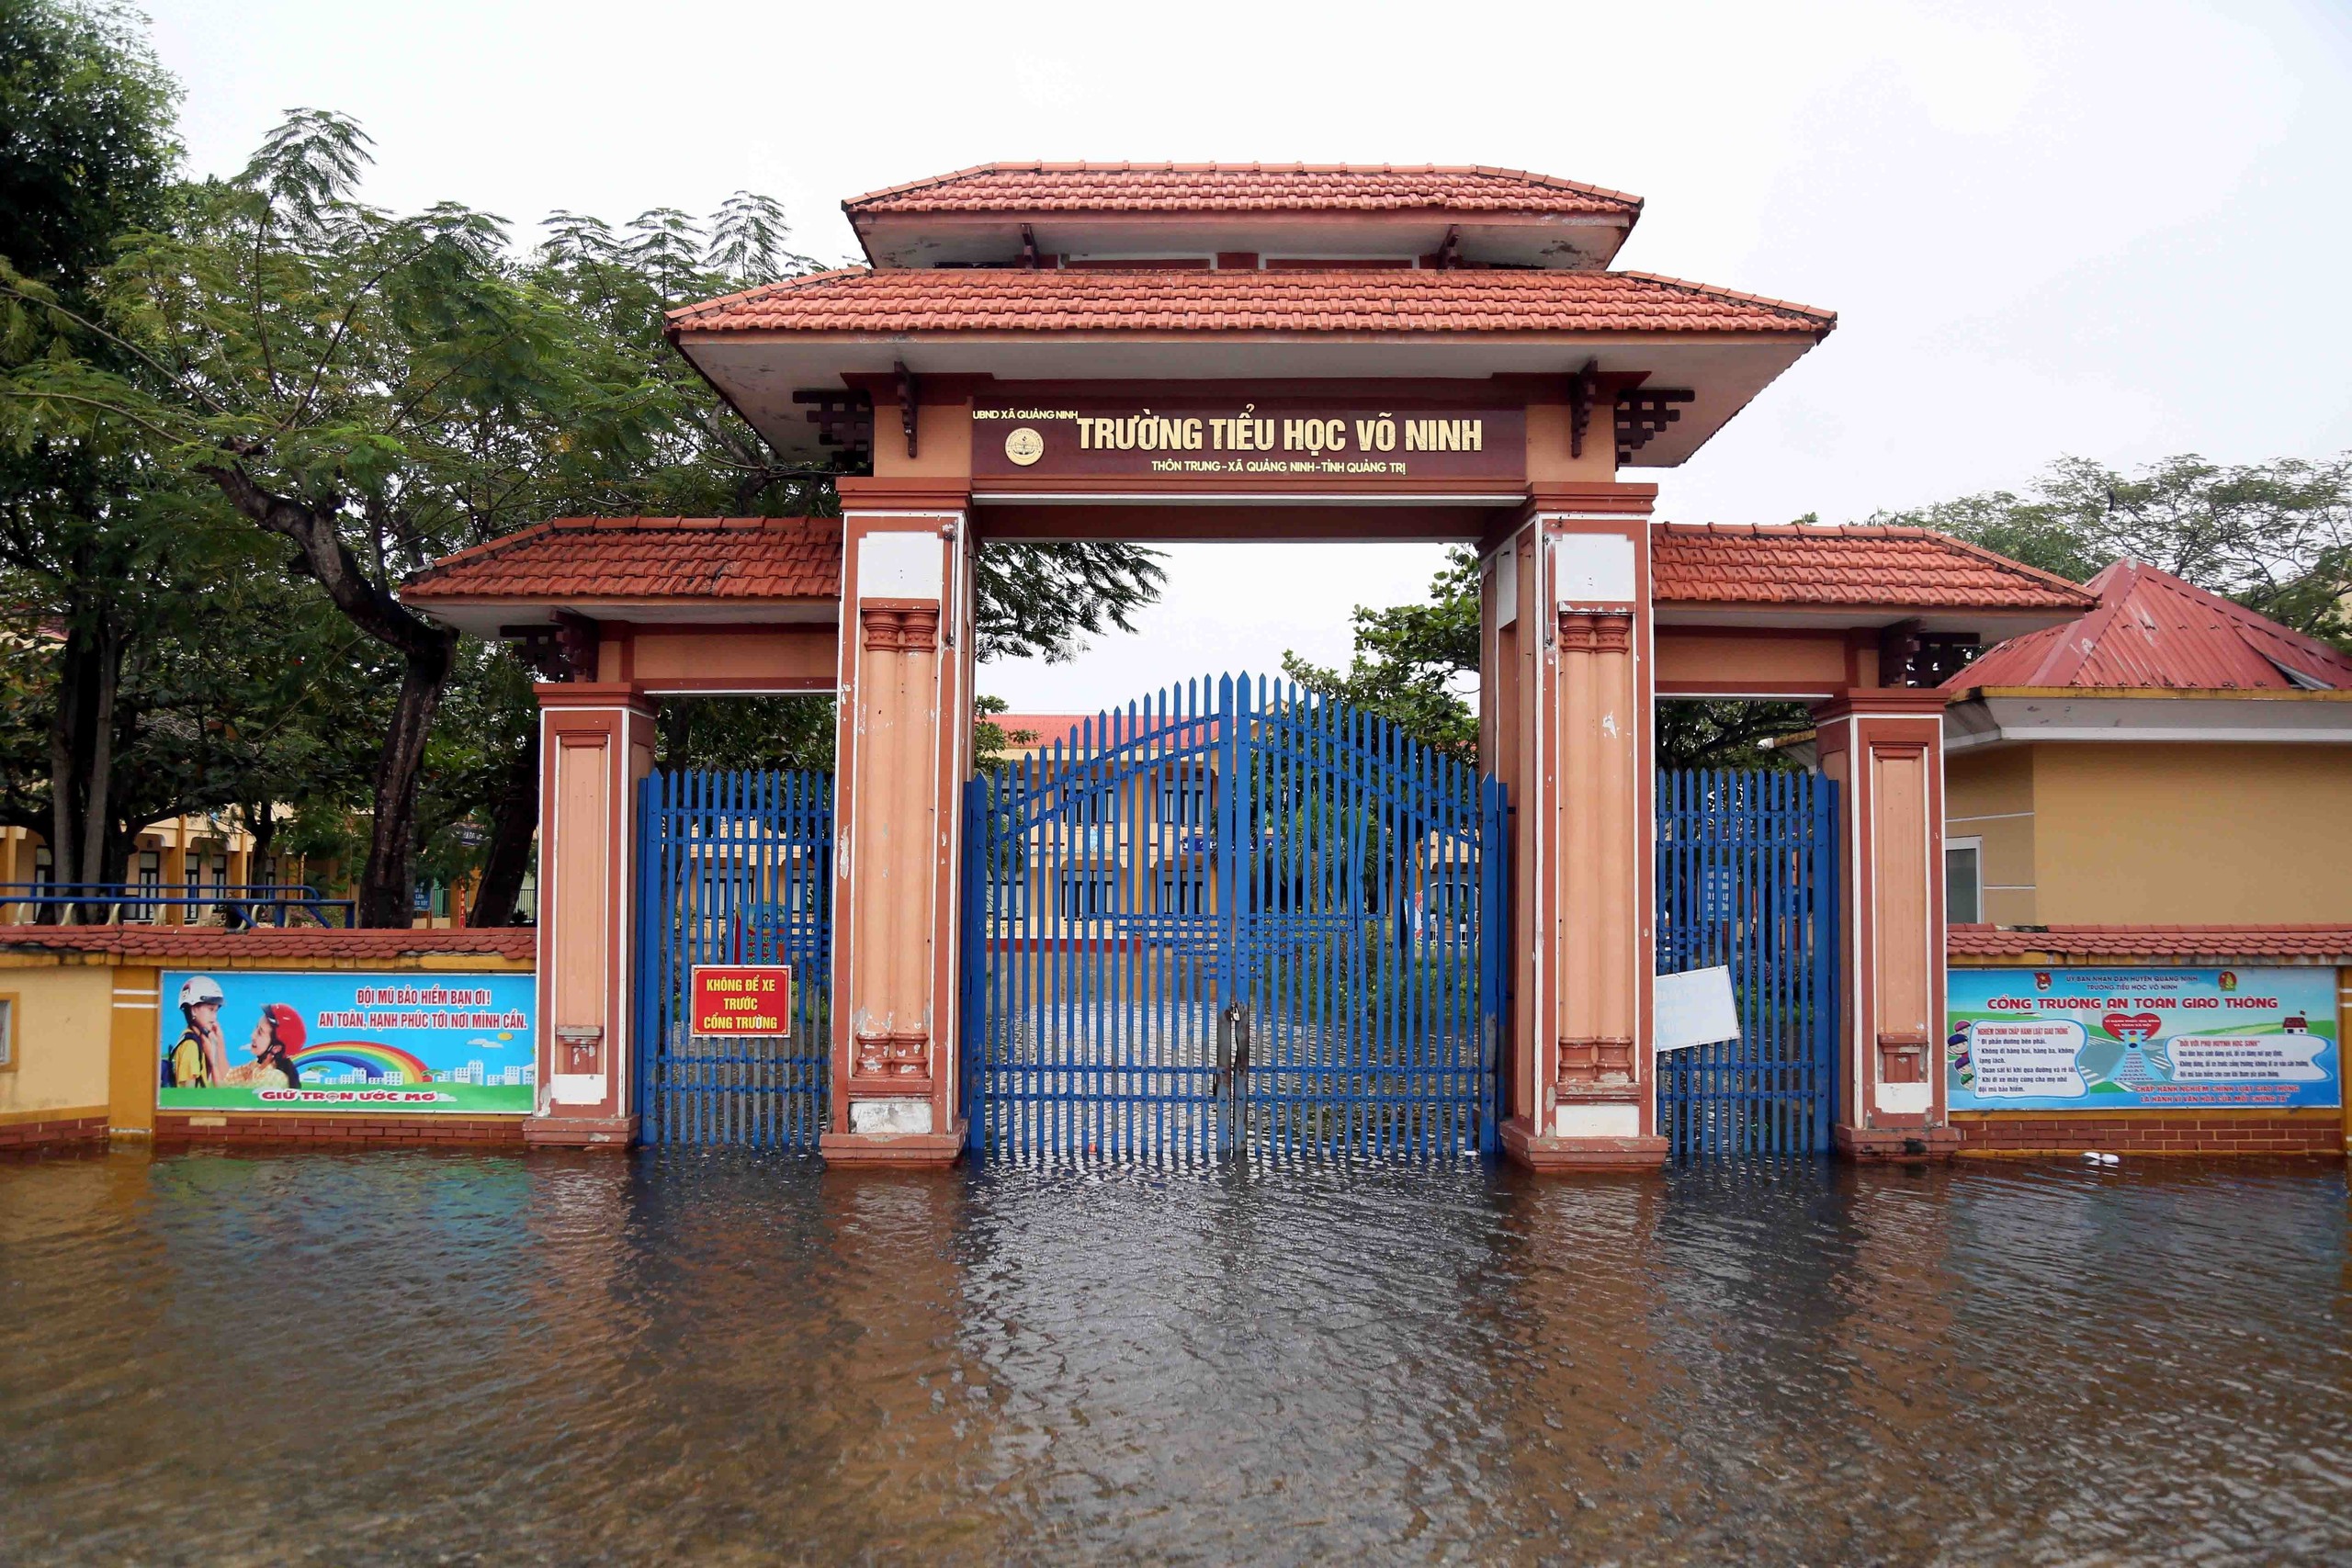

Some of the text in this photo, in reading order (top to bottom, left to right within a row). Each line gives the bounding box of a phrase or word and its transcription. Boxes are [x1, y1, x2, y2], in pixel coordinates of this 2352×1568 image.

[972, 407, 1079, 420] UBND XÃ QUẢNG NINH
[1076, 408, 1203, 450] TRƯỜNG
[1209, 403, 1275, 450] TIỂU
[1283, 419, 1346, 457] HỌC
[1355, 412, 1396, 452] VÕ
[1405, 419, 1482, 451] NINH
[1151, 458, 1182, 471] THÔN
[1246, 458, 1287, 472] QUẢNG
[1347, 458, 1387, 473] QUẢNG
[1389, 461, 1407, 476] TRỊ
[707, 974, 775, 992] KHÔNG ĐỂ XE
[357, 987, 375, 1007] ĐỘI
[378, 987, 394, 1004] MŨ
[397, 986, 418, 1004] BẢO
[422, 985, 447, 1004] HIỂM
[450, 990, 472, 1008] BẠN
[723, 995, 758, 1010] TRƯỚC
[1987, 994, 2032, 1009] CỔNG
[2107, 998, 2129, 1009] AN
[2134, 996, 2177, 1009] TOÀN
[2182, 998, 2220, 1009] GIAO
[2224, 996, 2278, 1009] THÔNG
[319, 1013, 334, 1027] AN
[337, 1010, 367, 1028] TOÀN,
[369, 1013, 398, 1031] HẠNH
[401, 1011, 429, 1028] PHÚC
[432, 1011, 448, 1028] TỚI
[451, 1012, 469, 1028] NƠI
[472, 1011, 500, 1028] MÌNH
[704, 1012, 778, 1030] CỔNG TRƯỜNG
[262, 1089, 297, 1100] GIỮ
[359, 1089, 399, 1100] ƯỚC
[404, 1091, 436, 1101] MƠ
